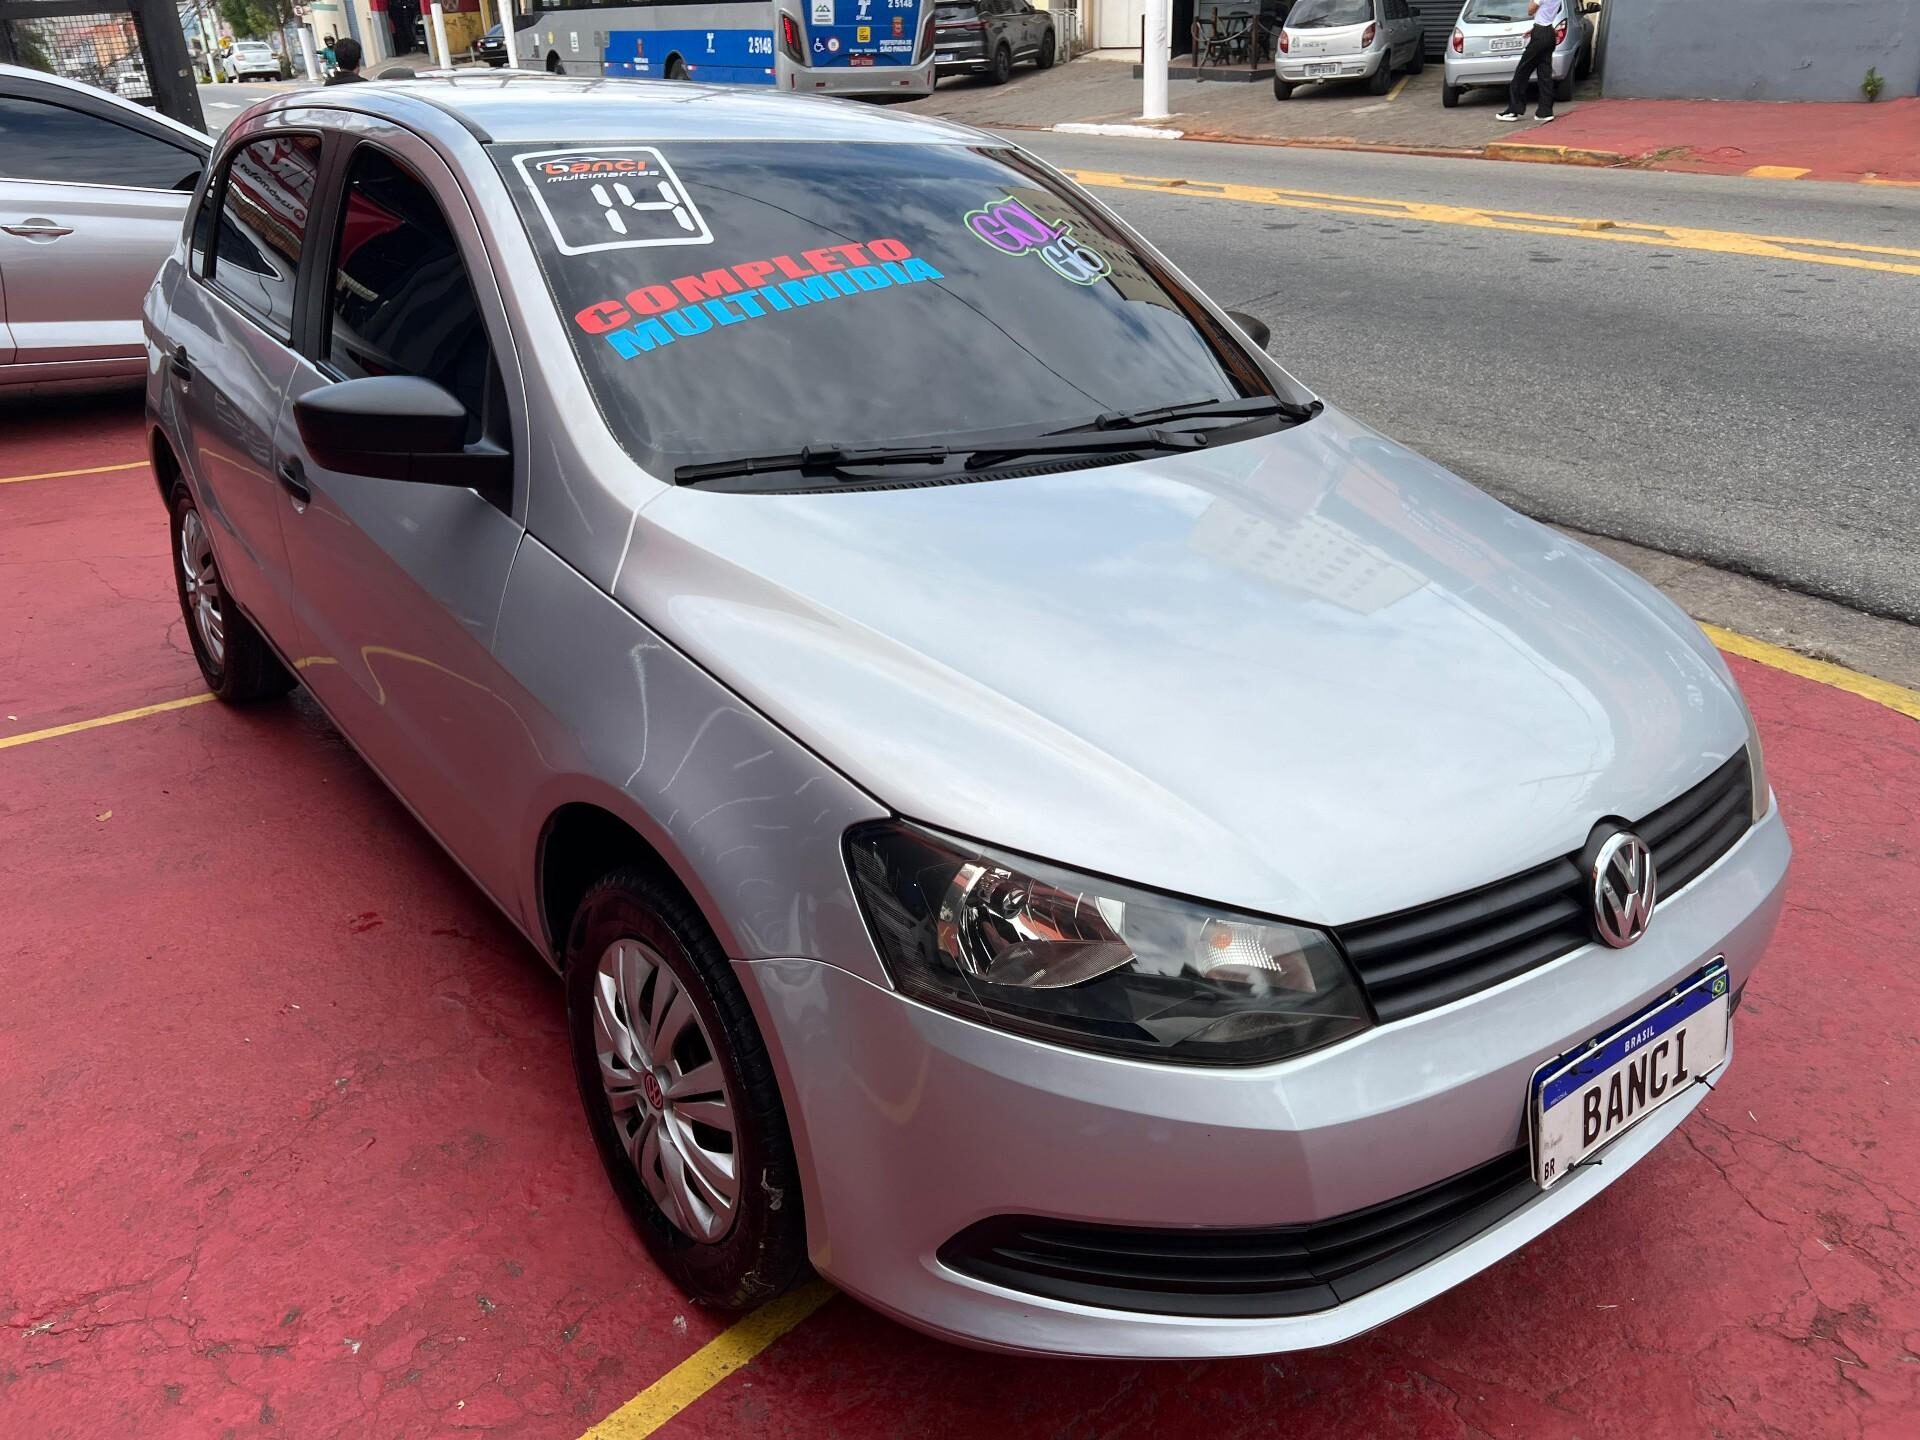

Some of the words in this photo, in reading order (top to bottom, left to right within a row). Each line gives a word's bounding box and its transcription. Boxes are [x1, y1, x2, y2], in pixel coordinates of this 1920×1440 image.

[547, 170, 659, 183] multimarcas
[590, 180, 695, 235] 14
[575, 238, 912, 334] COMPLETO
[605, 257, 945, 360] MULTIMIDIA
[1624, 1025, 1655, 1053] BRASIL
[1583, 1027, 1688, 1149] BANCI
[1544, 1157, 1555, 1180] BR
